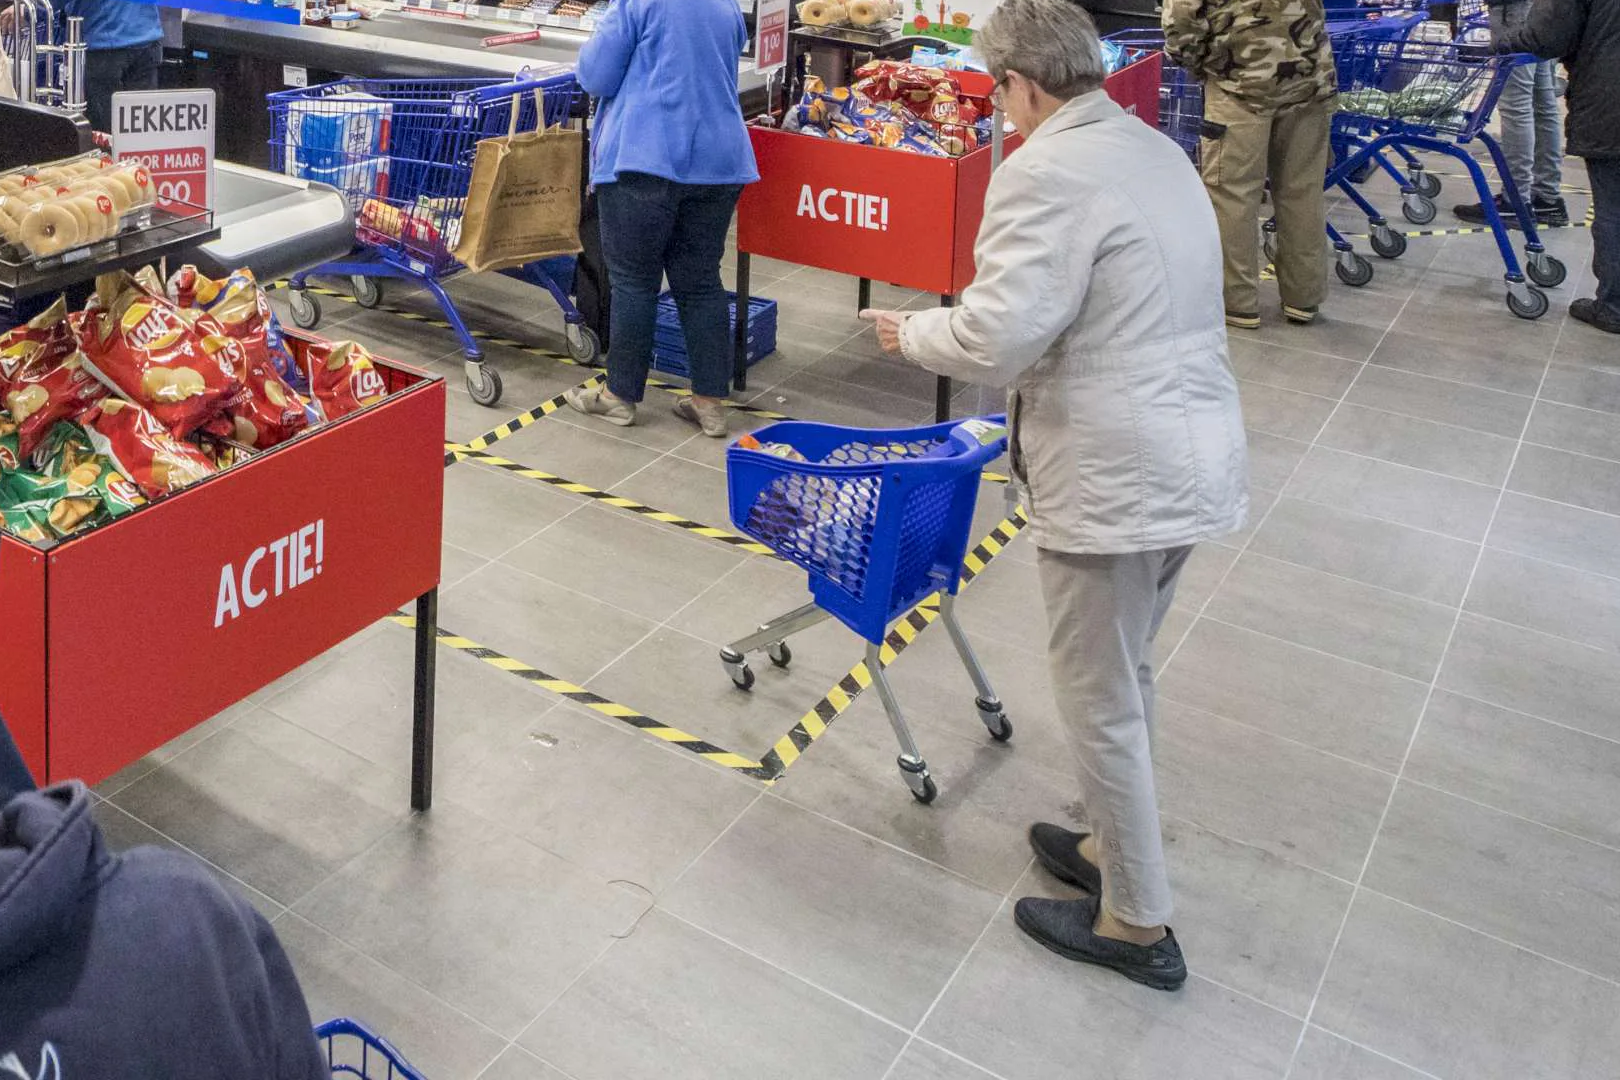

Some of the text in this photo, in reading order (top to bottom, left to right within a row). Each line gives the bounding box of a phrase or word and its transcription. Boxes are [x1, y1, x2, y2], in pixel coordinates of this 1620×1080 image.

[119, 103, 208, 134] LEKKER!
[796, 183, 890, 232] ACTIE!
[214, 518, 325, 628] ACTIE!
